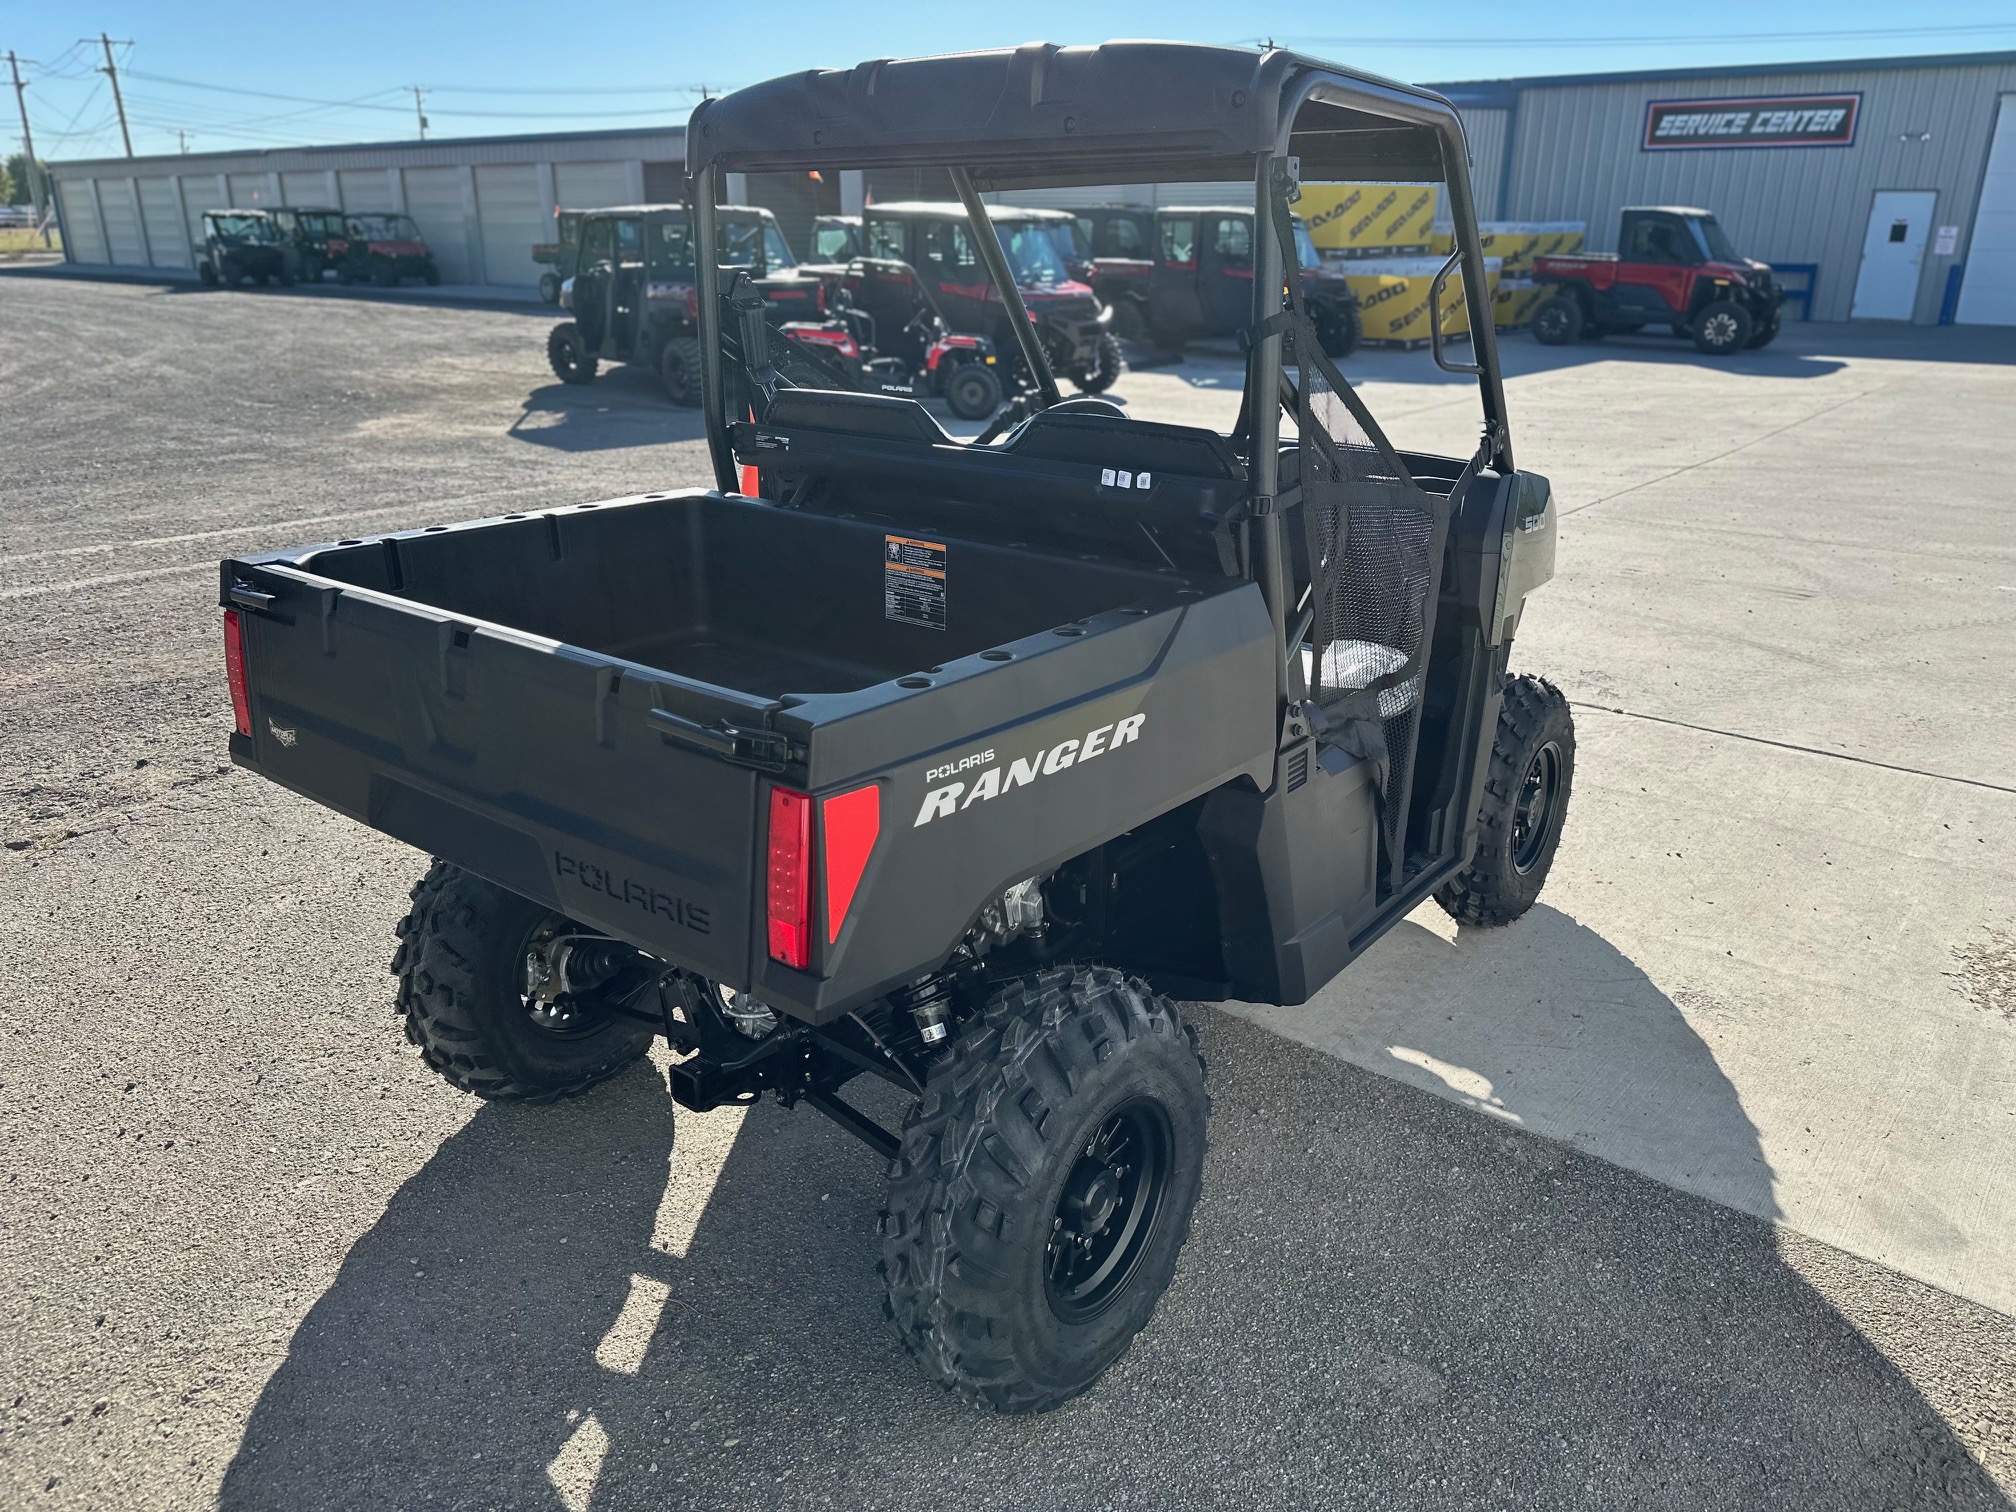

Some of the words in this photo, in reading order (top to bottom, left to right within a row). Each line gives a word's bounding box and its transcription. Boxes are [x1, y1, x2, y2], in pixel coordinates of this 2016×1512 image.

[1655, 111, 1751, 137] SERVICE
[1750, 108, 1847, 134] CENTER
[881, 384, 913, 393] POLARIS
[1525, 512, 1545, 534] 500
[913, 713, 1146, 828] RANGER
[926, 748, 995, 783] POLARIS
[555, 851, 711, 935] POLARIS
